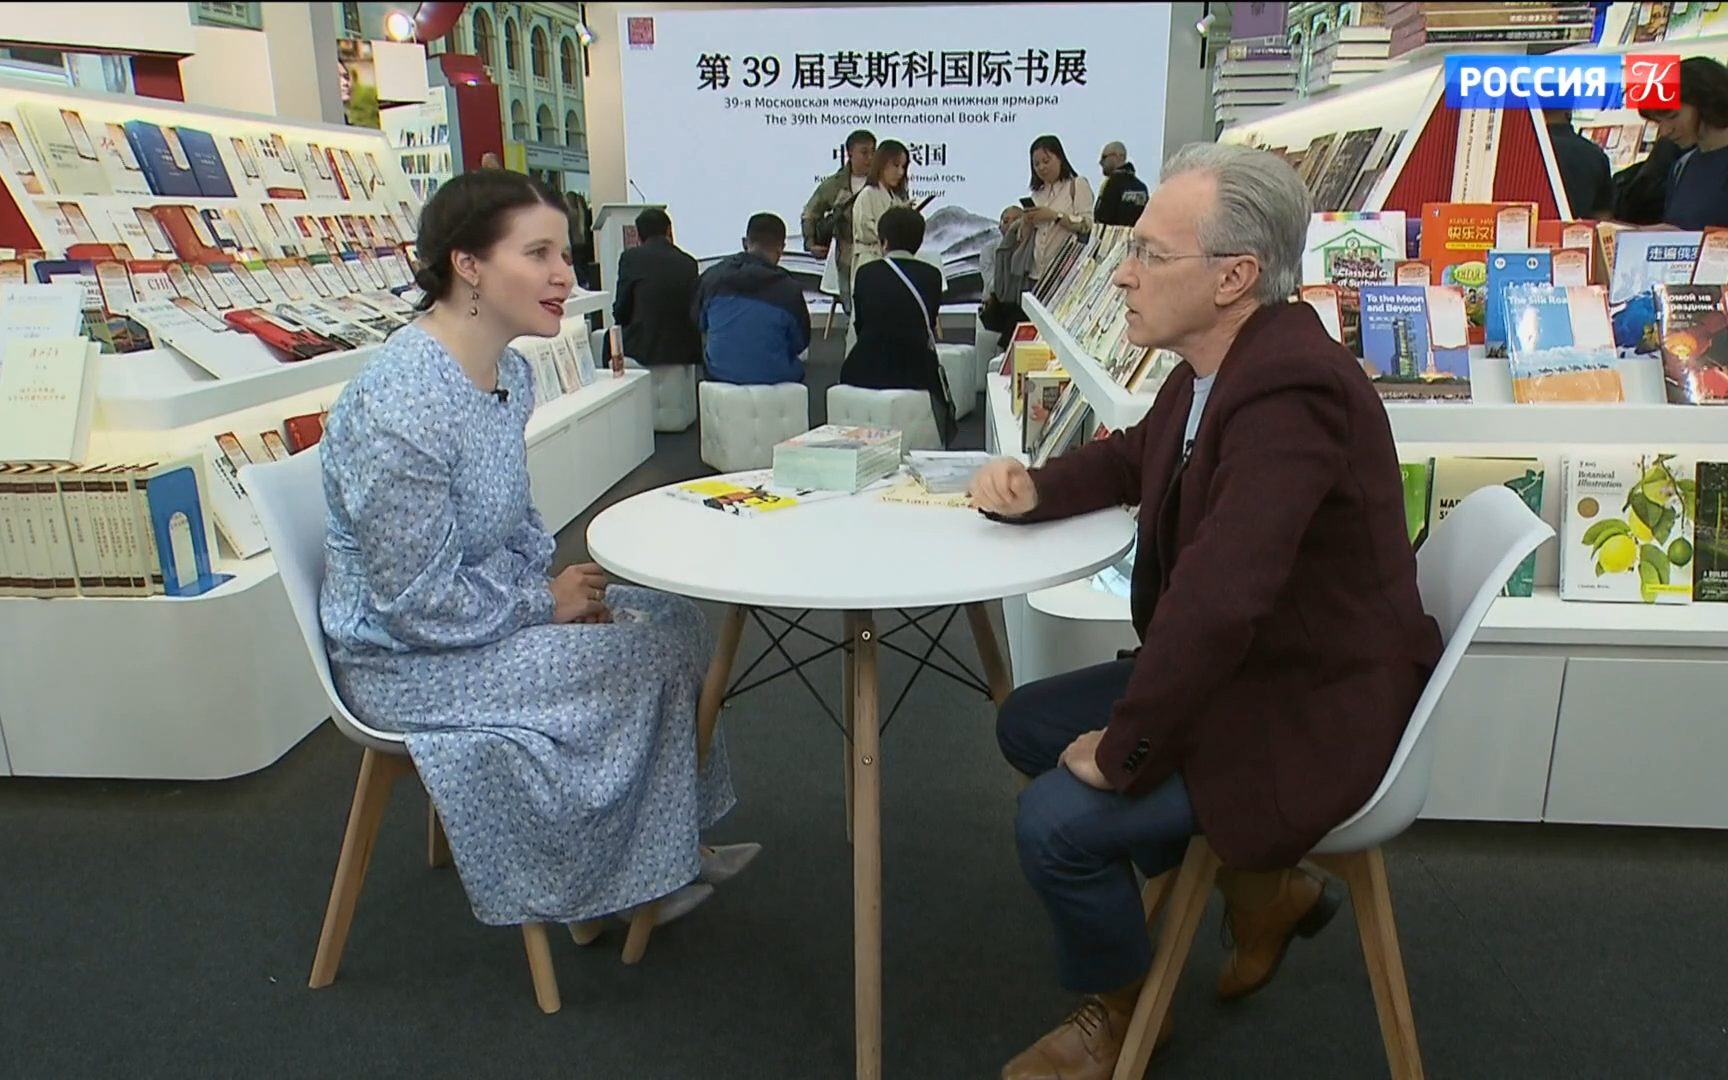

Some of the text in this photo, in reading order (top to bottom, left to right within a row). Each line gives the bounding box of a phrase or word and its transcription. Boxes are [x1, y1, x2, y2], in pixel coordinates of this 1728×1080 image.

[696, 49, 1087, 90] 第 39 届莫斯科国际书展
[724, 95, 1058, 109] 39-я Московская международная книжная ярмарка
[765, 111, 1017, 125] The 39th Moscow International Book Fair
[941, 175, 966, 183] гость
[1339, 268, 1377, 278] Classical
[1366, 294, 1424, 303] To the Moon
[1549, 296, 1568, 304] Roa
[1669, 293, 1696, 302] омой
[1367, 304, 1421, 313] and Beyond
[1670, 303, 1713, 312] раздник
[1578, 471, 1615, 479] Botanical
[1577, 479, 1622, 488] Illustration
